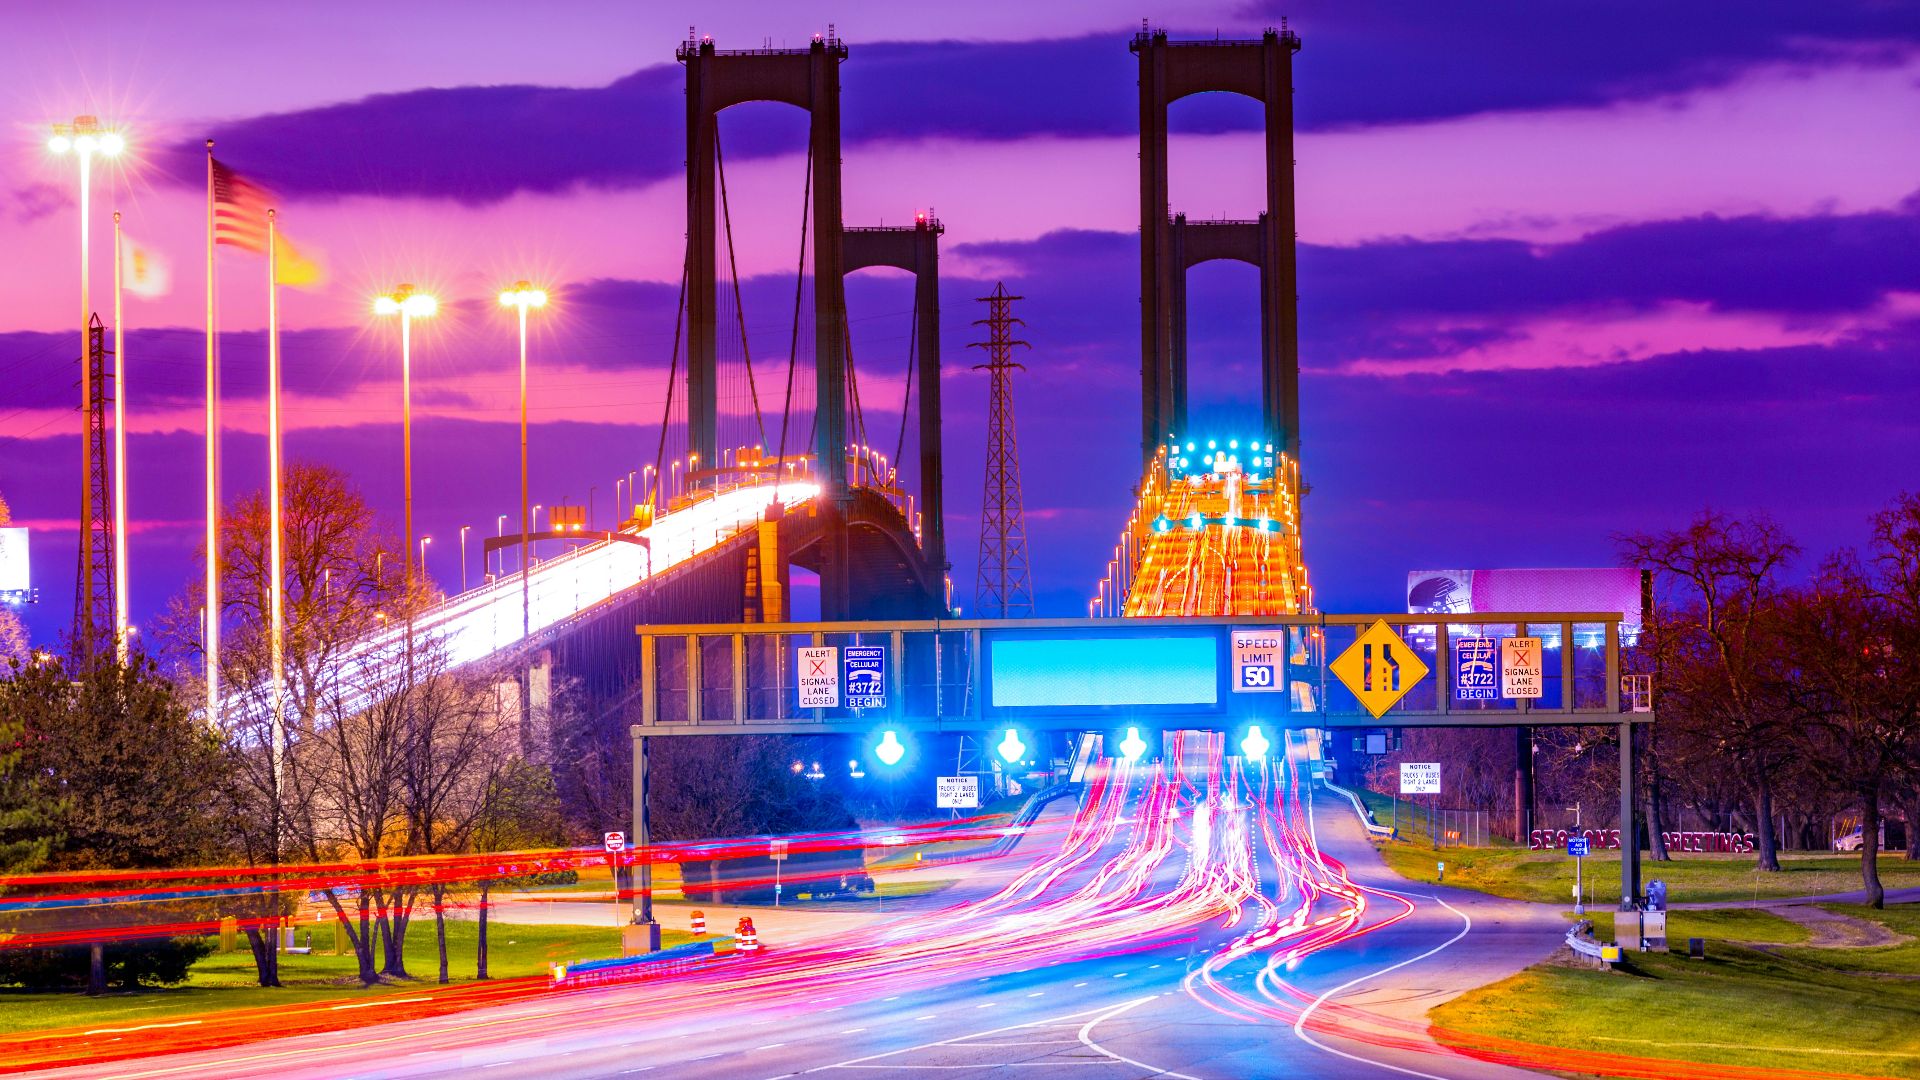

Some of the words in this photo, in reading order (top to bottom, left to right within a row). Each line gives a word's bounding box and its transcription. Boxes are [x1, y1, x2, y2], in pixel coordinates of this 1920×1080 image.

[1237, 639, 1278, 649] SPEED
[1509, 640, 1534, 648] ALERT
[804, 649, 831, 658] ALERT
[1241, 653, 1273, 663] LIMIT
[1245, 666, 1270, 686] 50
[1504, 668, 1540, 676] SIGNALS
[801, 677, 836, 686] SIGNALS
[1460, 673, 1494, 685] #3722
[1511, 678, 1533, 686] LANE
[807, 687, 830, 695] LANE
[848, 681, 882, 694] #3722
[1506, 687, 1539, 695] CLOSED
[1460, 689, 1494, 699] BEGIN
[802, 696, 835, 705] CLOSED
[849, 697, 882, 707] BEGIN
[1530, 829, 1621, 851] SEAONS
